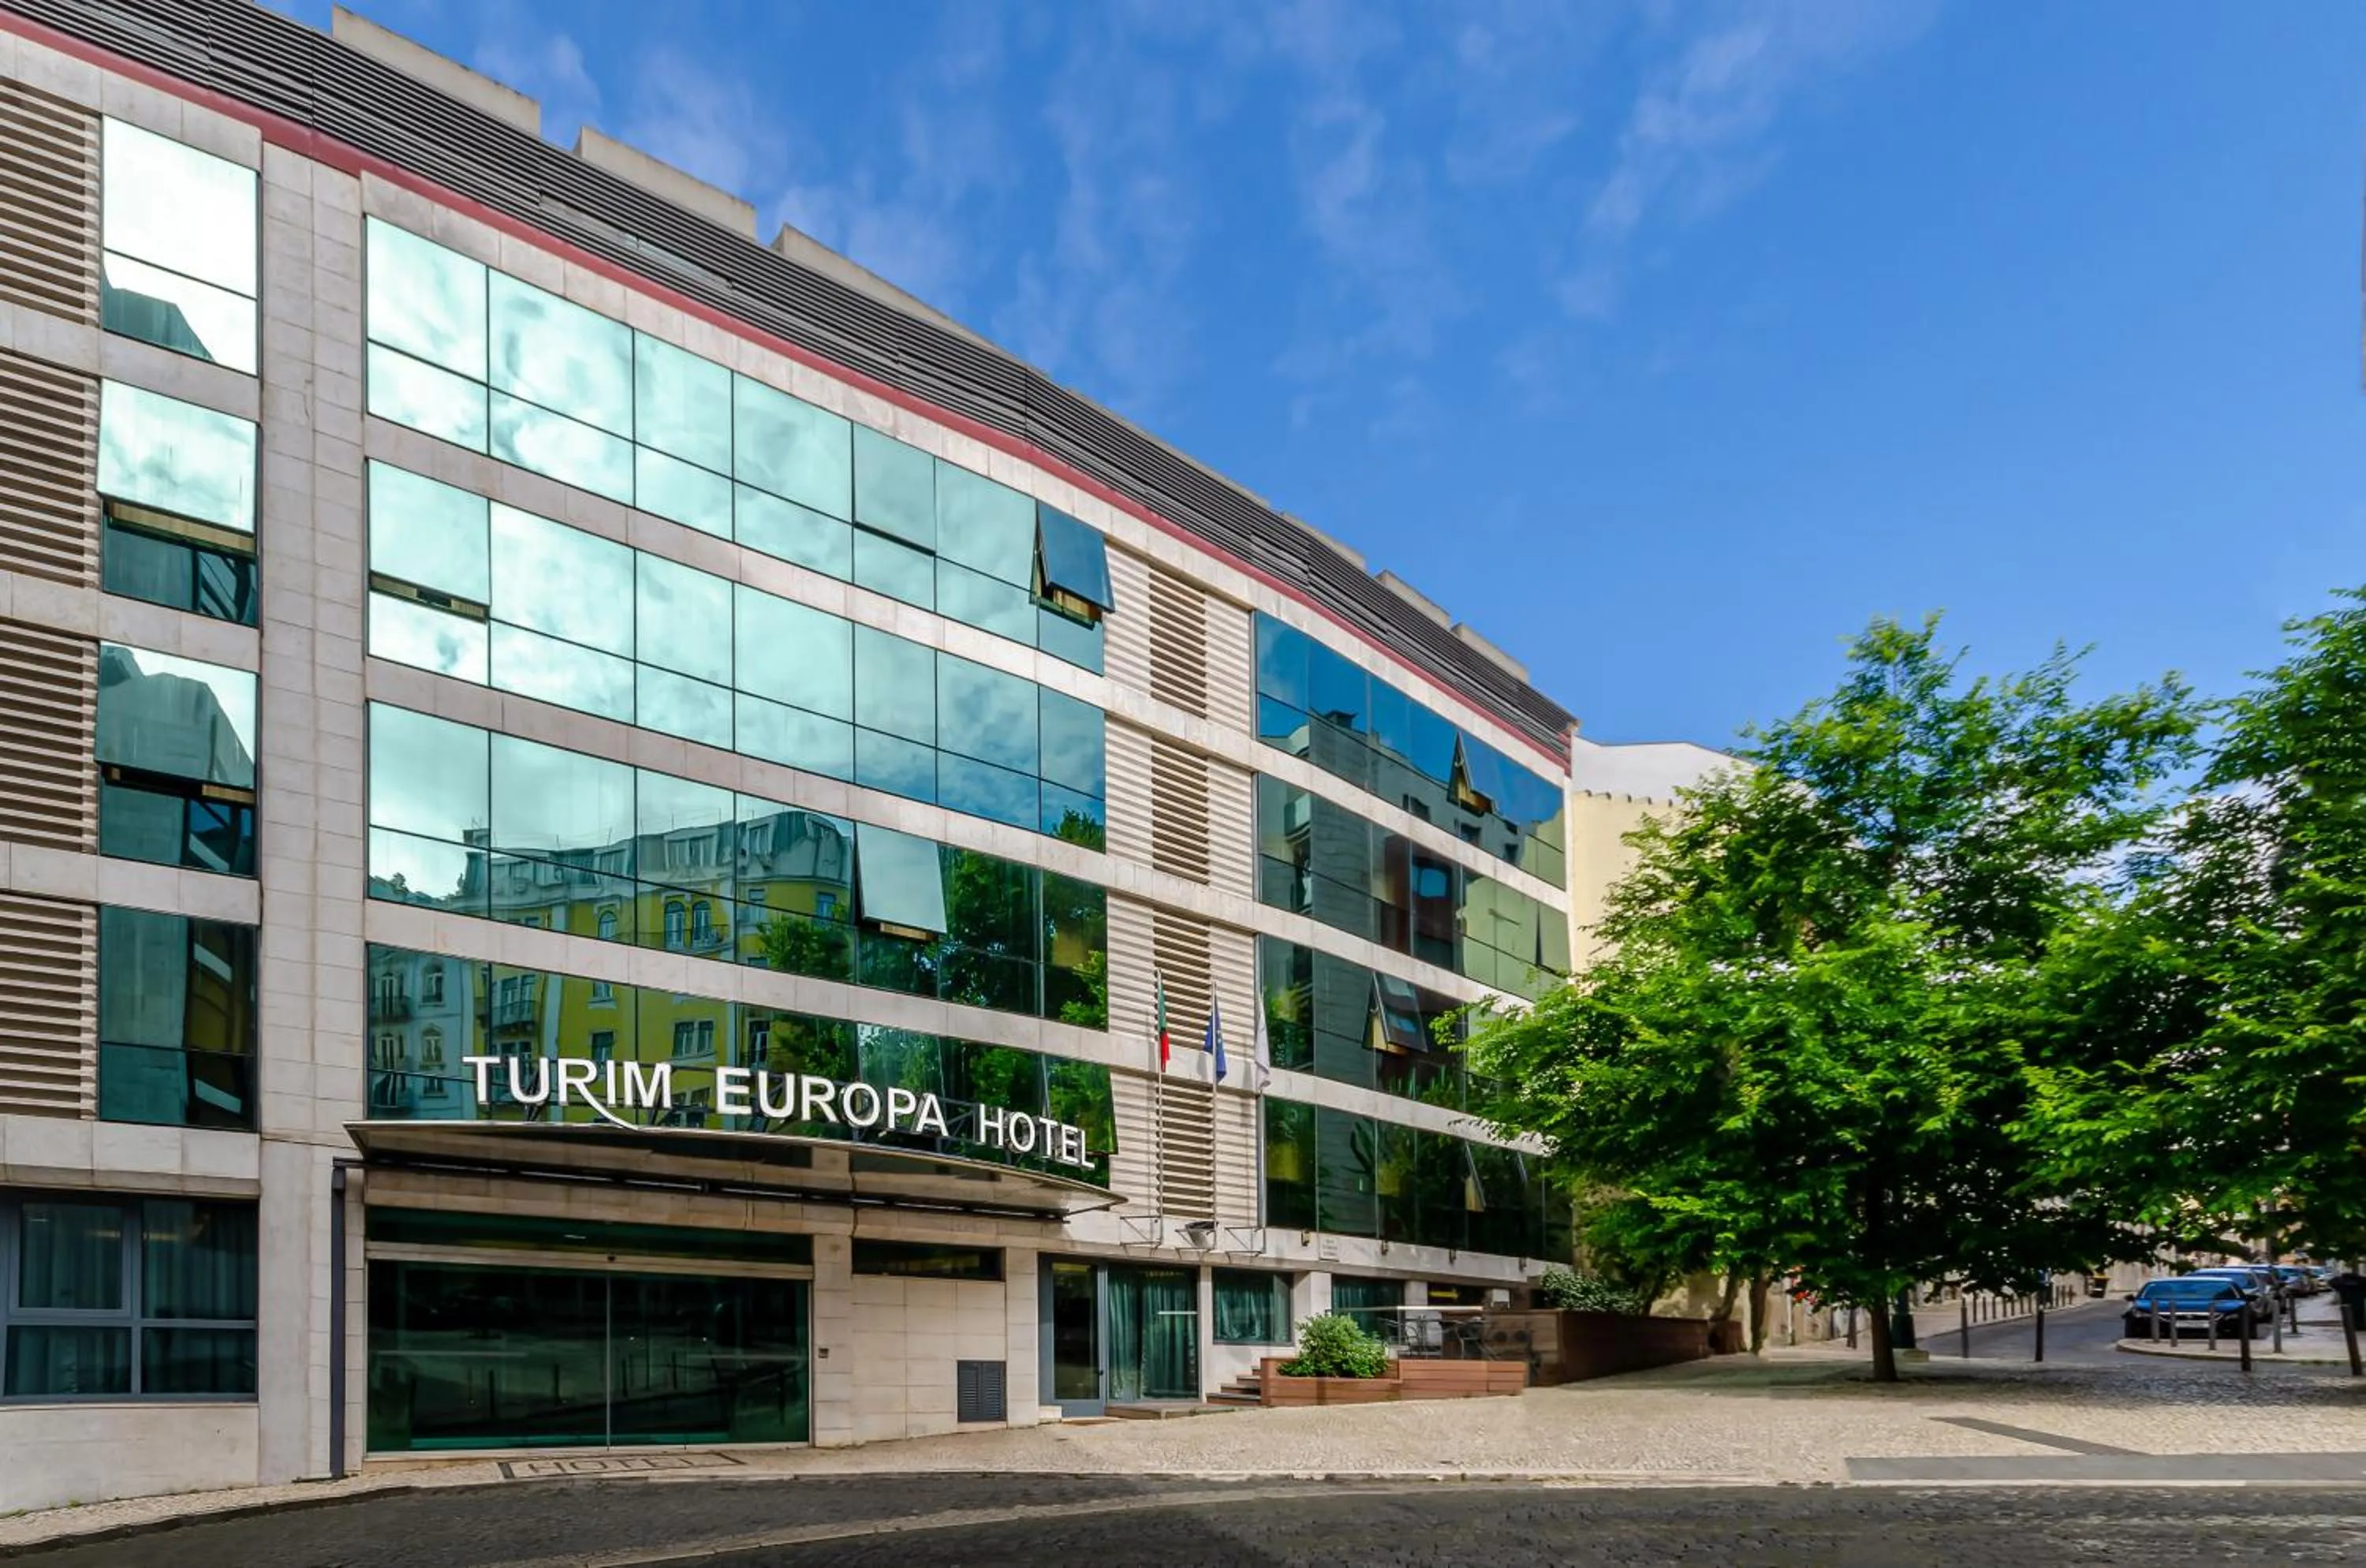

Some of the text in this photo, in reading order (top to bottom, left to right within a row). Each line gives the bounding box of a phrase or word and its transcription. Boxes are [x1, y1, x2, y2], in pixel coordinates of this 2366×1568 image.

[462, 1056, 1095, 1170] TURIM EUROPA HOTEL
[528, 1458, 702, 1473] HOTEL
